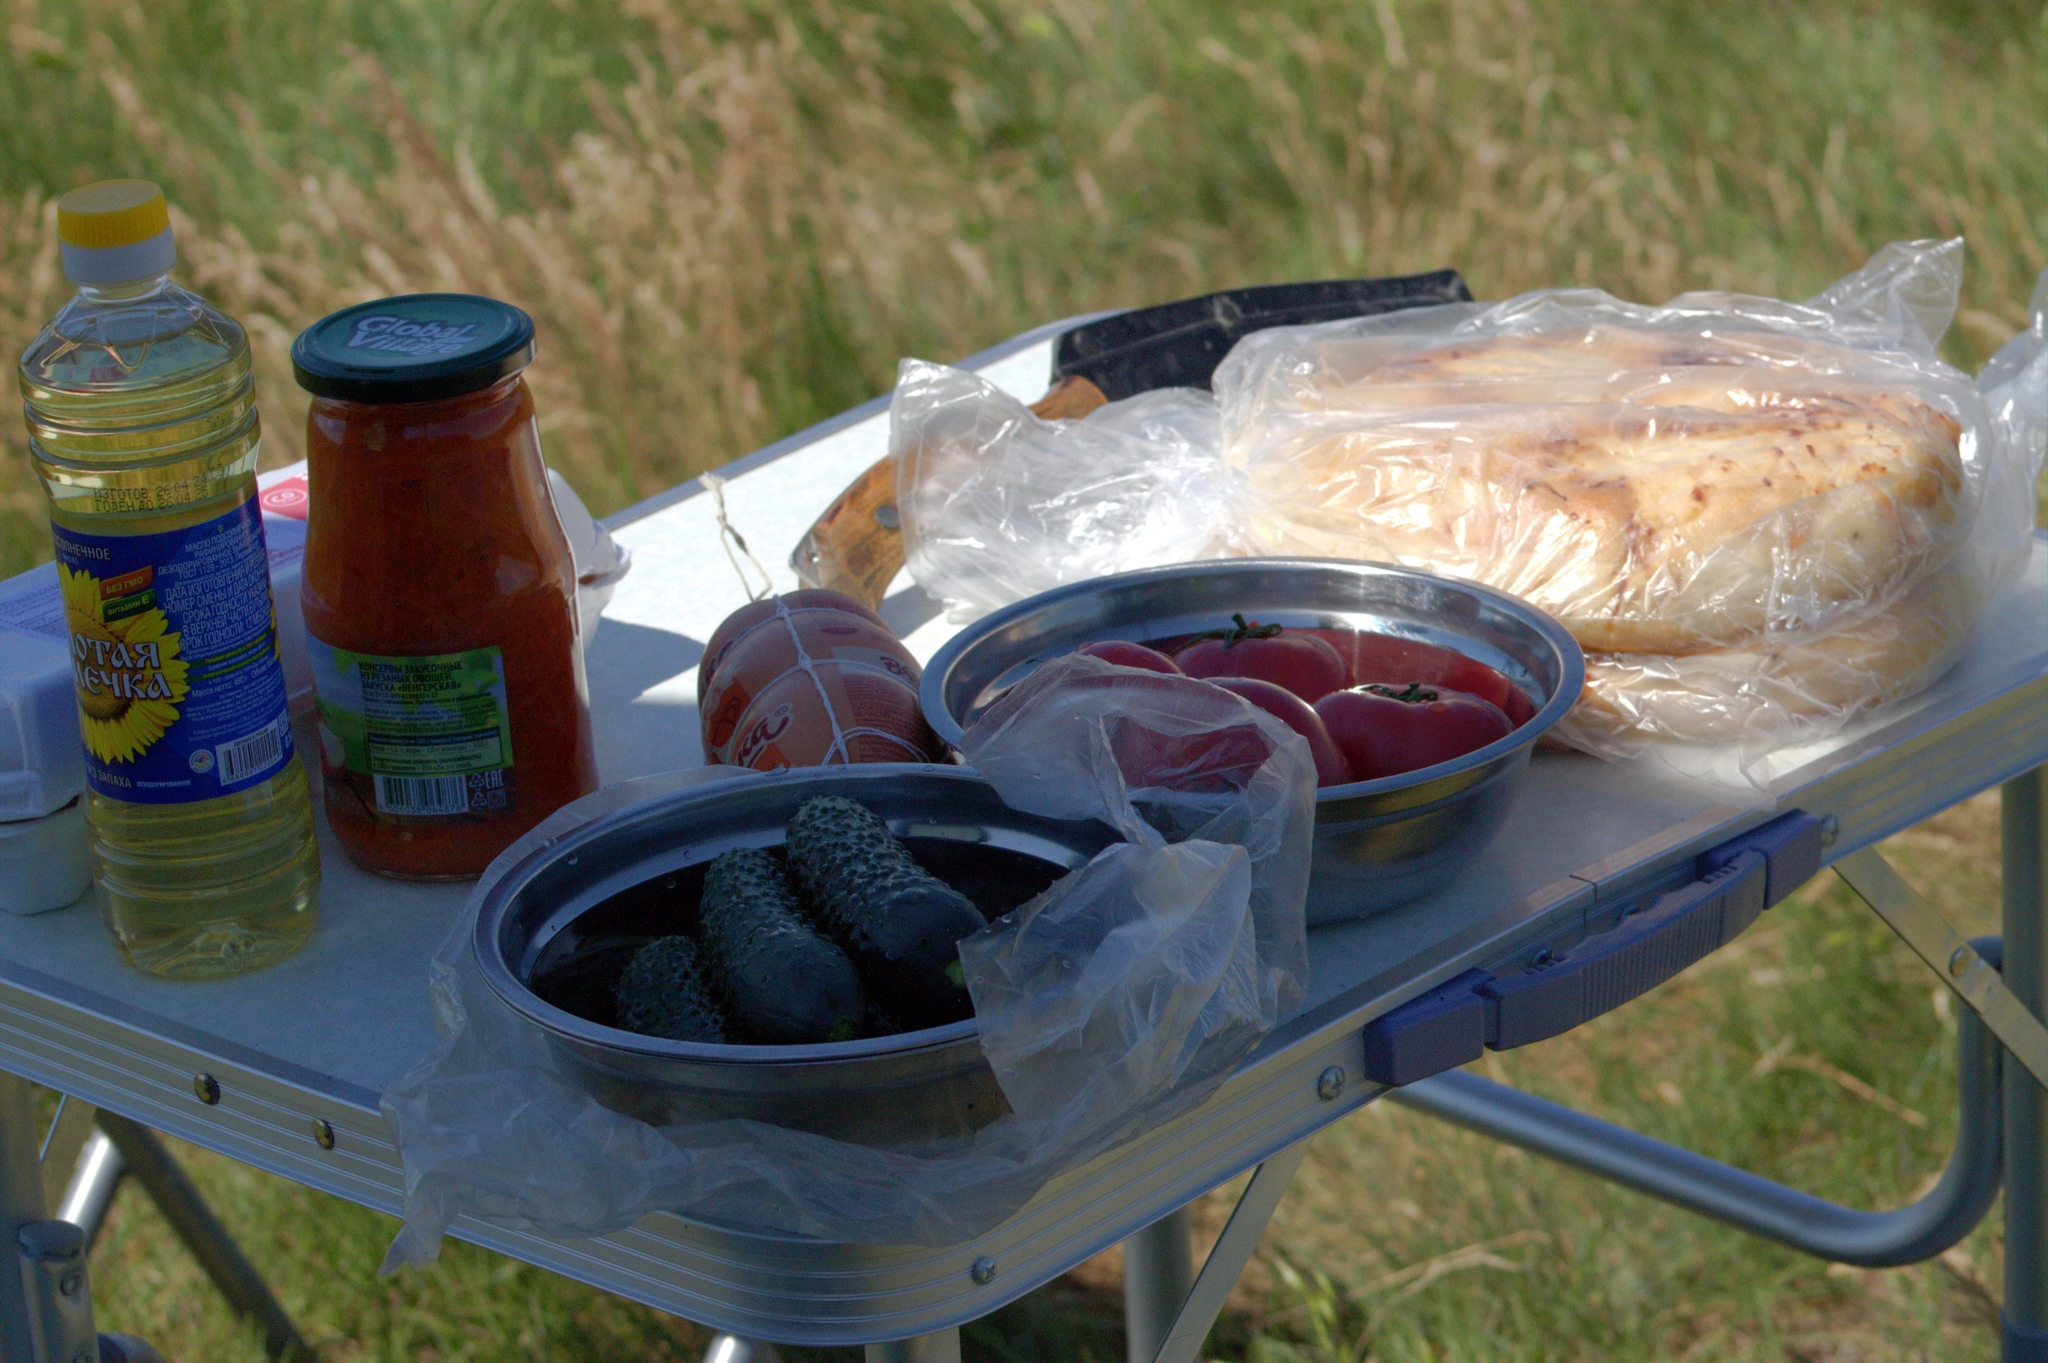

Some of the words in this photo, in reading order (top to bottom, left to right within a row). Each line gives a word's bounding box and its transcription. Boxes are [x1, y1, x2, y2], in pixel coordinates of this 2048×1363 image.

[357, 315, 478, 344] Global
[347, 330, 464, 356] Village
[106, 583, 123, 594] БЕЗ
[124, 576, 144, 590] ГМО
[165, 585, 188, 601] ДАТА
[163, 597, 196, 614] НОМЕР
[182, 606, 211, 624] СРОКА
[179, 637, 204, 652] СРОК
[359, 662, 402, 673] КОНСЕРВЫ
[404, 660, 463, 673] ЗАКУСОЧНЫЕ
[360, 672, 370, 680] ИЗ
[371, 673, 411, 682] РЕЗАНЫХ
[361, 680, 395, 691] ЗАКУСКА
